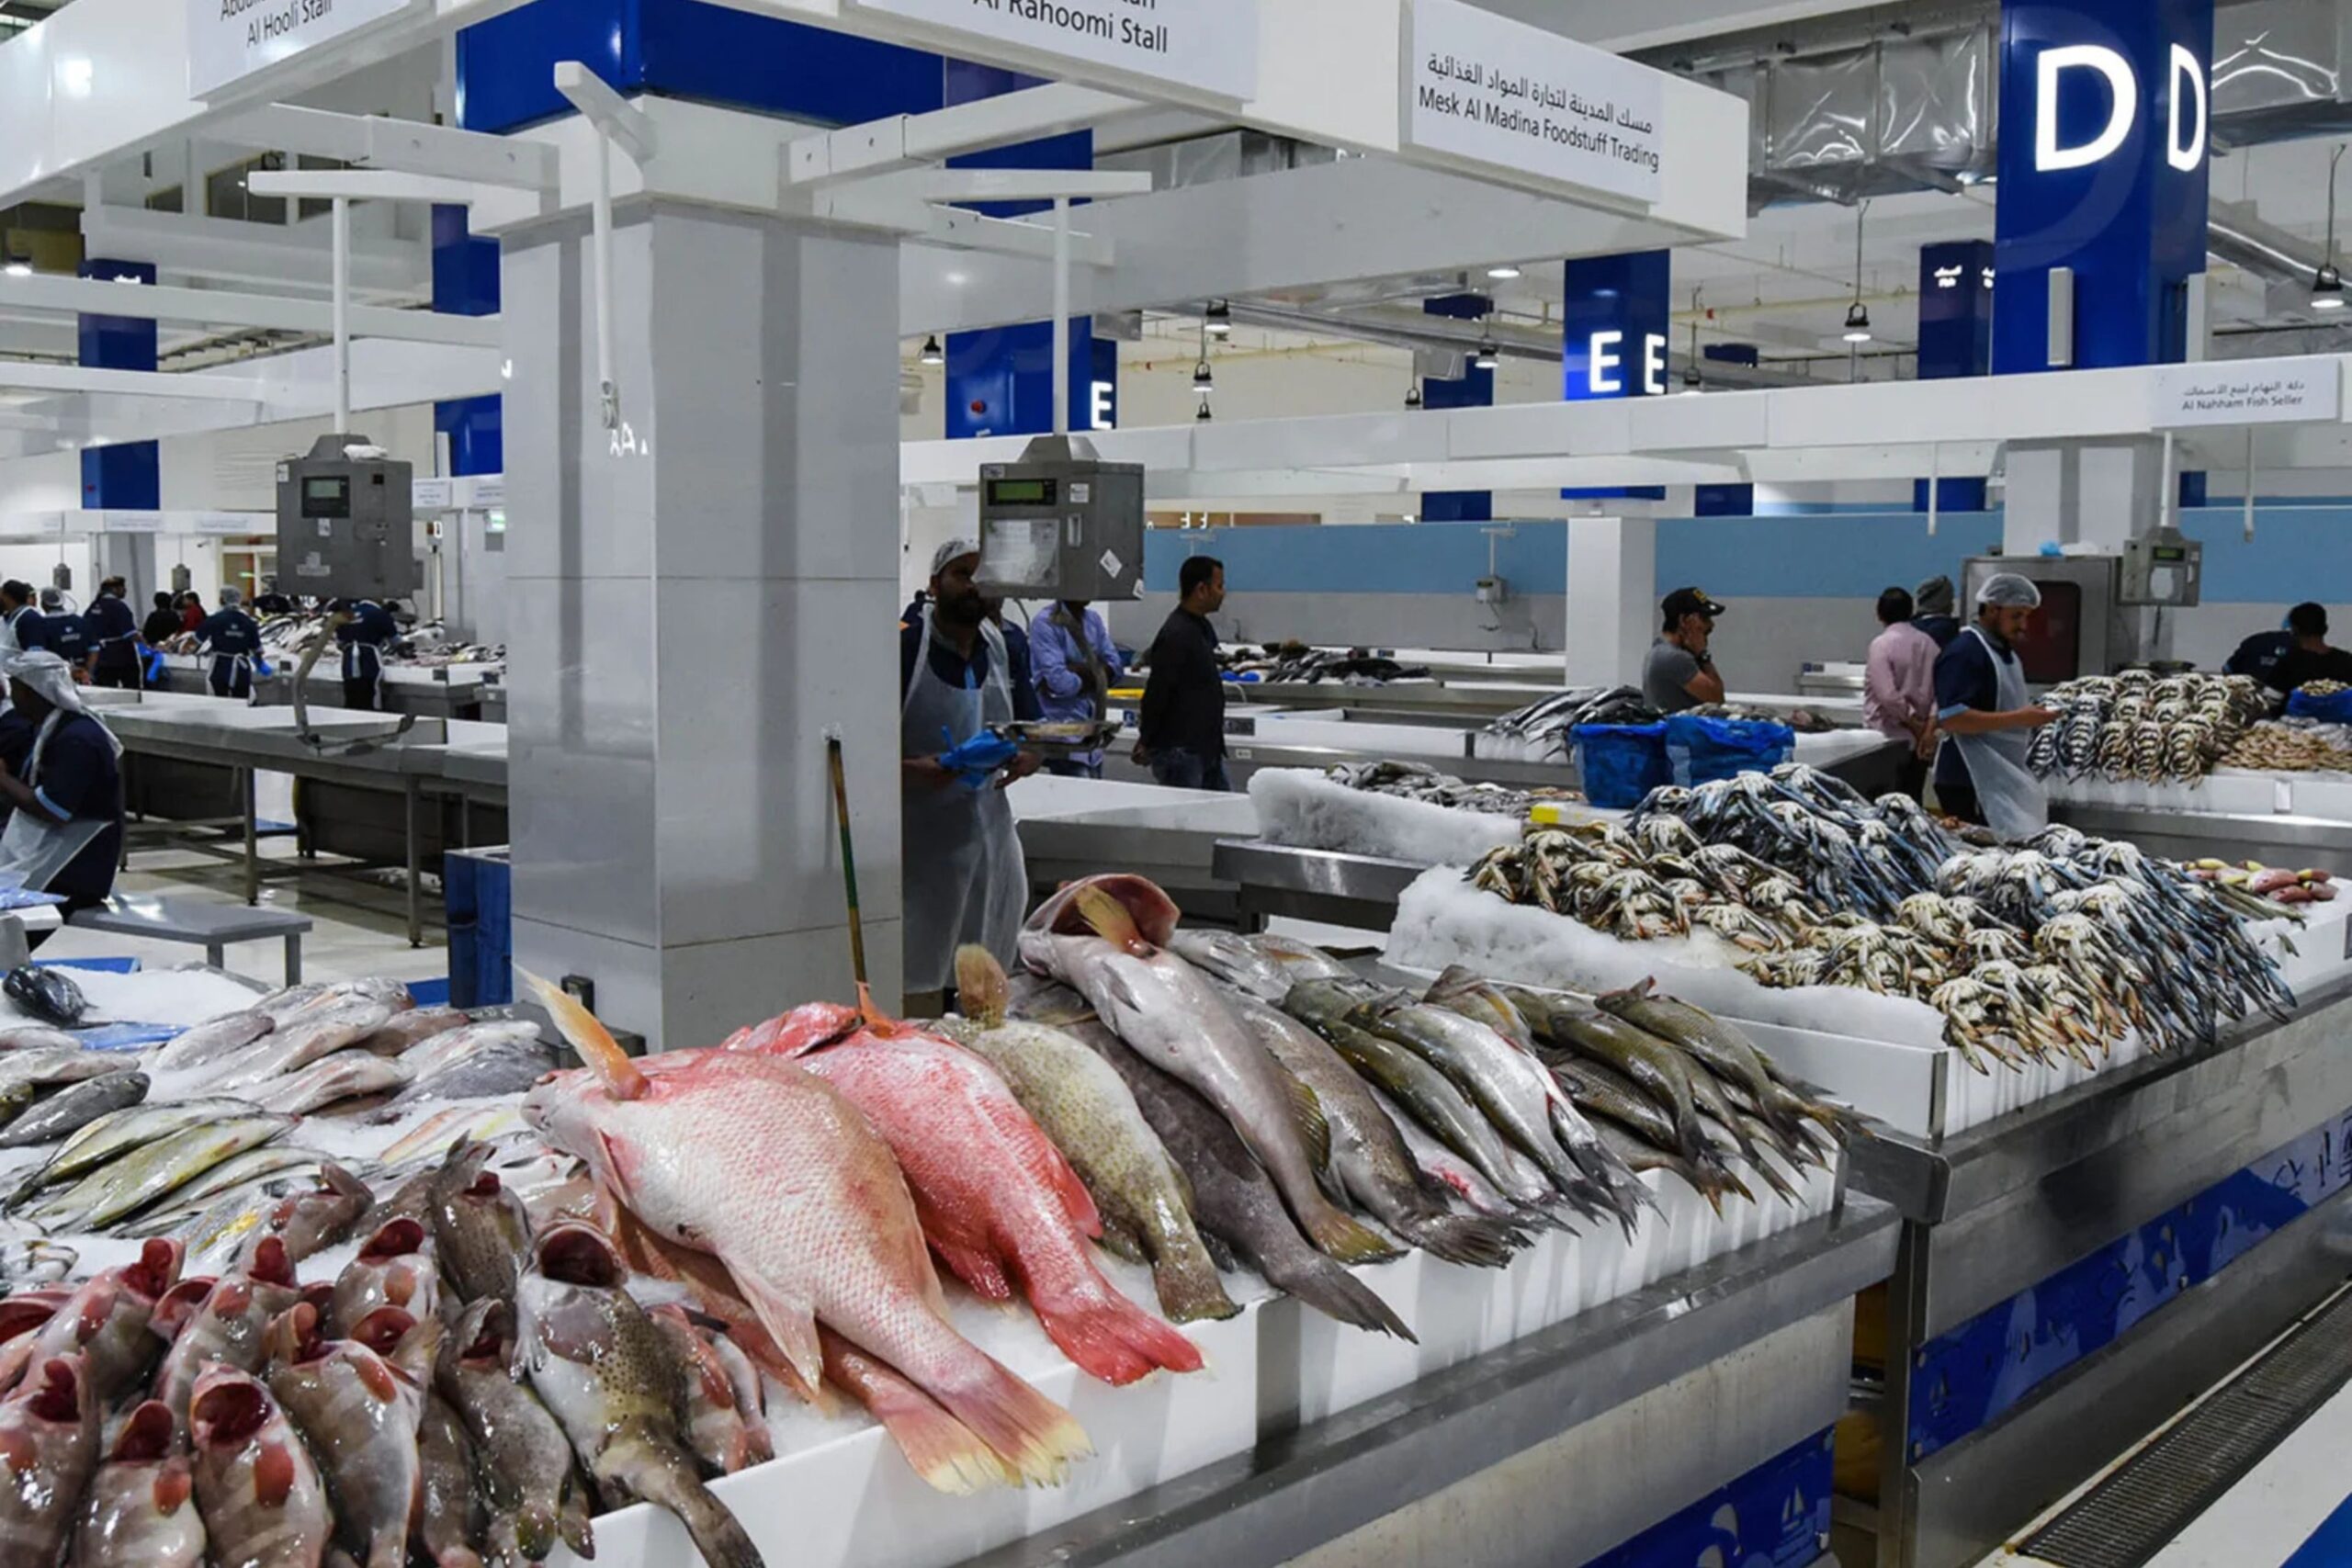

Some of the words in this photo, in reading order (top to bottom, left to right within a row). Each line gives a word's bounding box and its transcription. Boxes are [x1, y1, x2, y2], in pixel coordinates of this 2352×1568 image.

[247, 17, 260, 48] Al
[263, 0, 299, 41] Hooli
[1010, 0, 1114, 39] Rahoomi
[1121, 17, 1167, 53] Stall
[1427, 52, 1483, 85] الغذائية
[1487, 69, 1528, 98] المواد
[1532, 83, 1566, 111] لتجارة
[1569, 94, 1614, 123] المدينة
[1616, 108, 1653, 134] مسك
[2035, 44, 2137, 172] D
[2167, 42, 2205, 172] D
[1419, 85, 1460, 117] Mesk
[1464, 97, 1481, 121] Al
[1485, 102, 1540, 137] Madina
[1543, 118, 1608, 155] Foodstuff
[1610, 136, 1659, 174] Trading
[1589, 331, 1623, 393] E
[1645, 333, 1666, 393] E
[1091, 380, 1114, 430] E
[2182, 400, 2195, 412] Al
[2246, 396, 2269, 408] Fish
[2270, 394, 2303, 407] Seller
